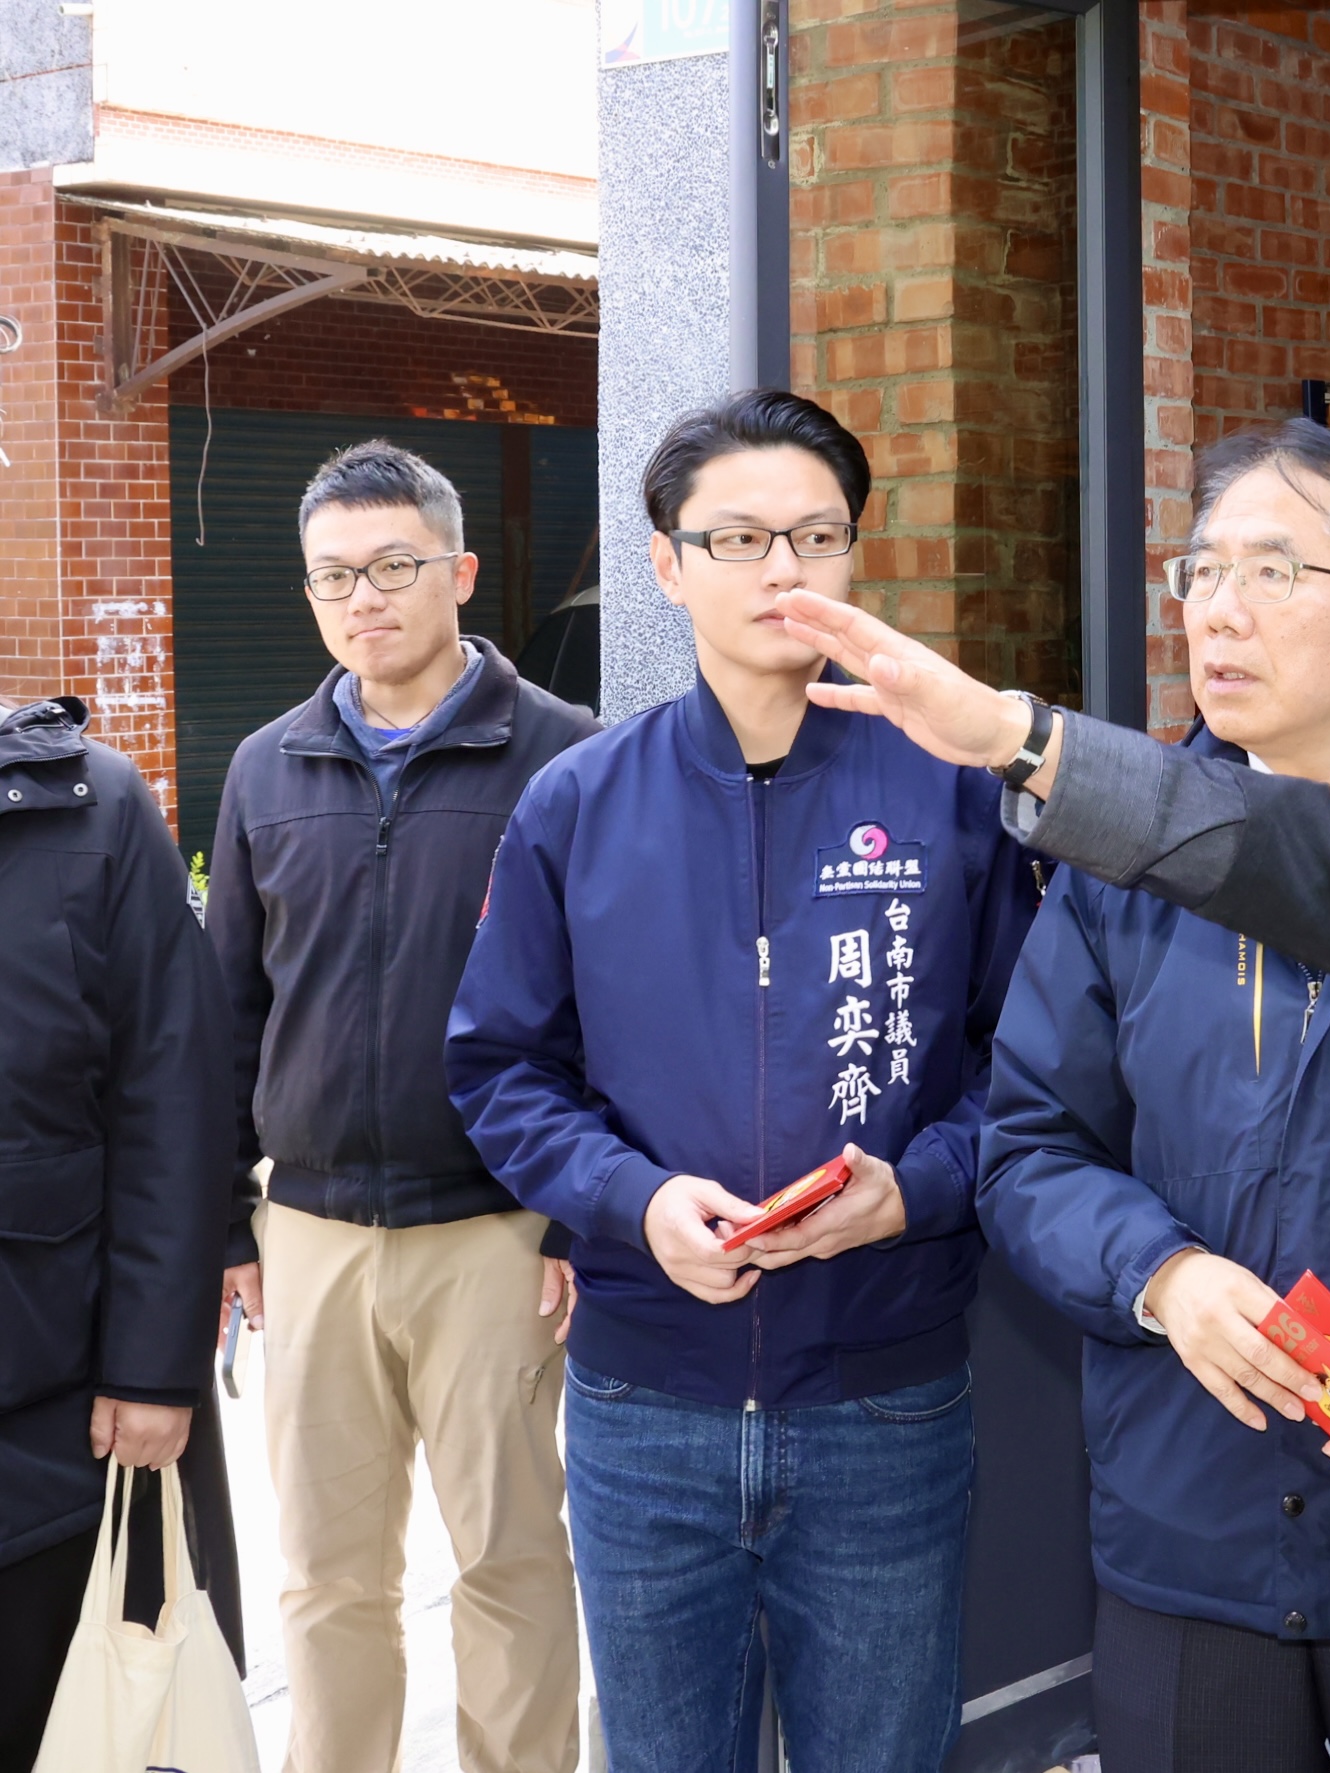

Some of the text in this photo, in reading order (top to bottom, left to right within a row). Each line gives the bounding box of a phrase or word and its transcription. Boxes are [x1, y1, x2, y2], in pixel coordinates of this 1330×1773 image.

[819, 879, 921, 893] Non-Partisan Solidarity Union
[827, 929, 881, 1126] 周奕齊
[884, 898, 917, 1085] 台南市議員
